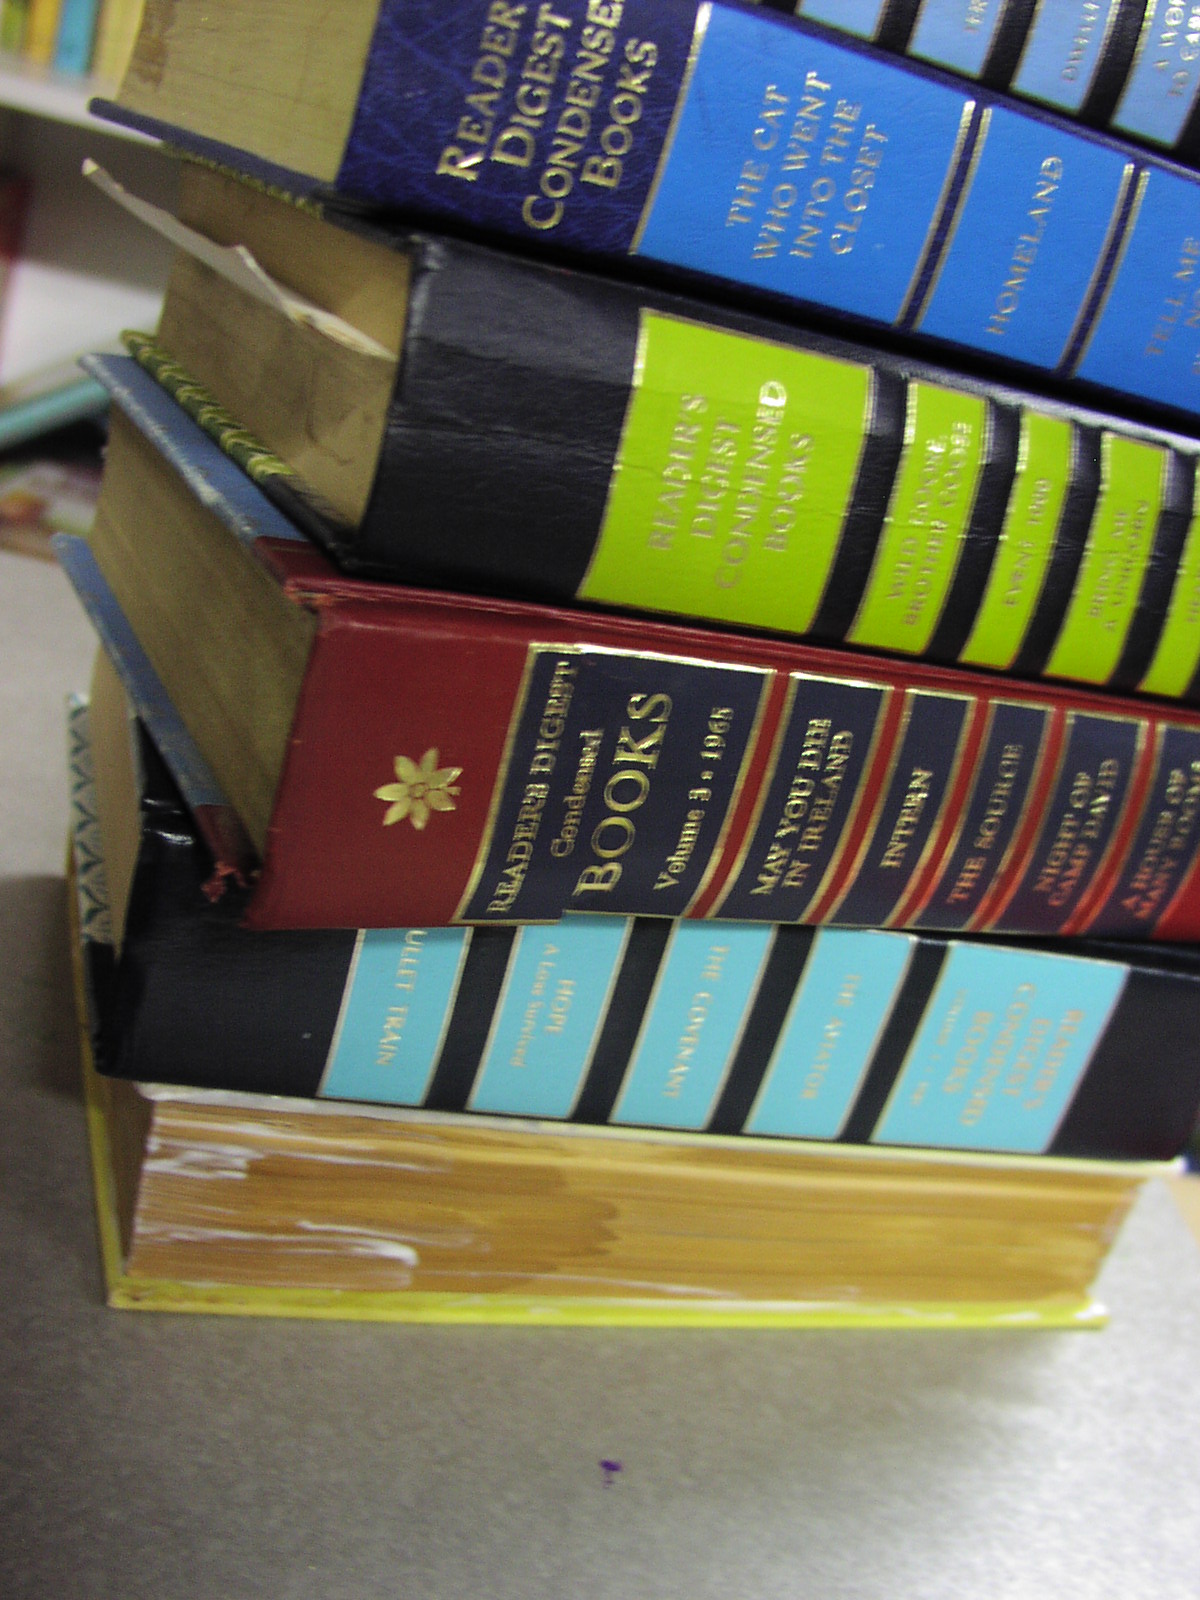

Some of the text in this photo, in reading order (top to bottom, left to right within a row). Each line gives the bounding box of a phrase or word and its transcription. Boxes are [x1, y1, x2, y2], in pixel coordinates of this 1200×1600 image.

[491, 2, 572, 167] DIGEST
[522, 0, 625, 230] CONDENSE
[580, 38, 658, 188] BOOKS
[725, 85, 789, 227] THE CAT
[751, 71, 831, 259] WHO WENT
[790, 99, 862, 259] INTO THE
[830, 124, 888, 255] CLOSET
[985, 156, 1063, 335] HOMELAND
[1145, 237, 1200, 356] TELL ME
[647, 393, 709, 551] READER'S
[690, 417, 740, 538] DIGEST
[714, 380, 787, 589] CONDENSED
[763, 433, 815, 552] BOOKS
[903, 421, 973, 625] BROTHER GOOSE
[886, 537, 918, 599] WILD
[1000, 540, 1035, 607] EVENT
[486, 660, 579, 913] READER'S DIGEST
[550, 728, 604, 858] Condensed
[571, 693, 673, 896] BOOKS
[653, 809, 706, 891] Volume
[688, 787, 712, 802] 3
[750, 718, 832, 895] MAY YOU DIE
[781, 731, 853, 888] IN IRELAND
[879, 766, 933, 868] INTERN
[947, 744, 1023, 904] THE SOURCE
[1033, 772, 1093, 892] NIGHT OF
[1048, 759, 1118, 906] CAMP DAVID
[376, 930, 428, 1066] ULLET TRAIN
[509, 943, 560, 1068] A Loss Survived
[545, 979, 577, 1035] HOPE
[662, 945, 730, 1098] THE COVENANT
[802, 973, 862, 1099] THE AVIATOR
[942, 1010, 994, 1093] BOOKS
[959, 983, 1036, 1126] CONDENSED
[1003, 1018, 1052, 1096] DIGEST
[1022, 1009, 1085, 1110] READER'S
